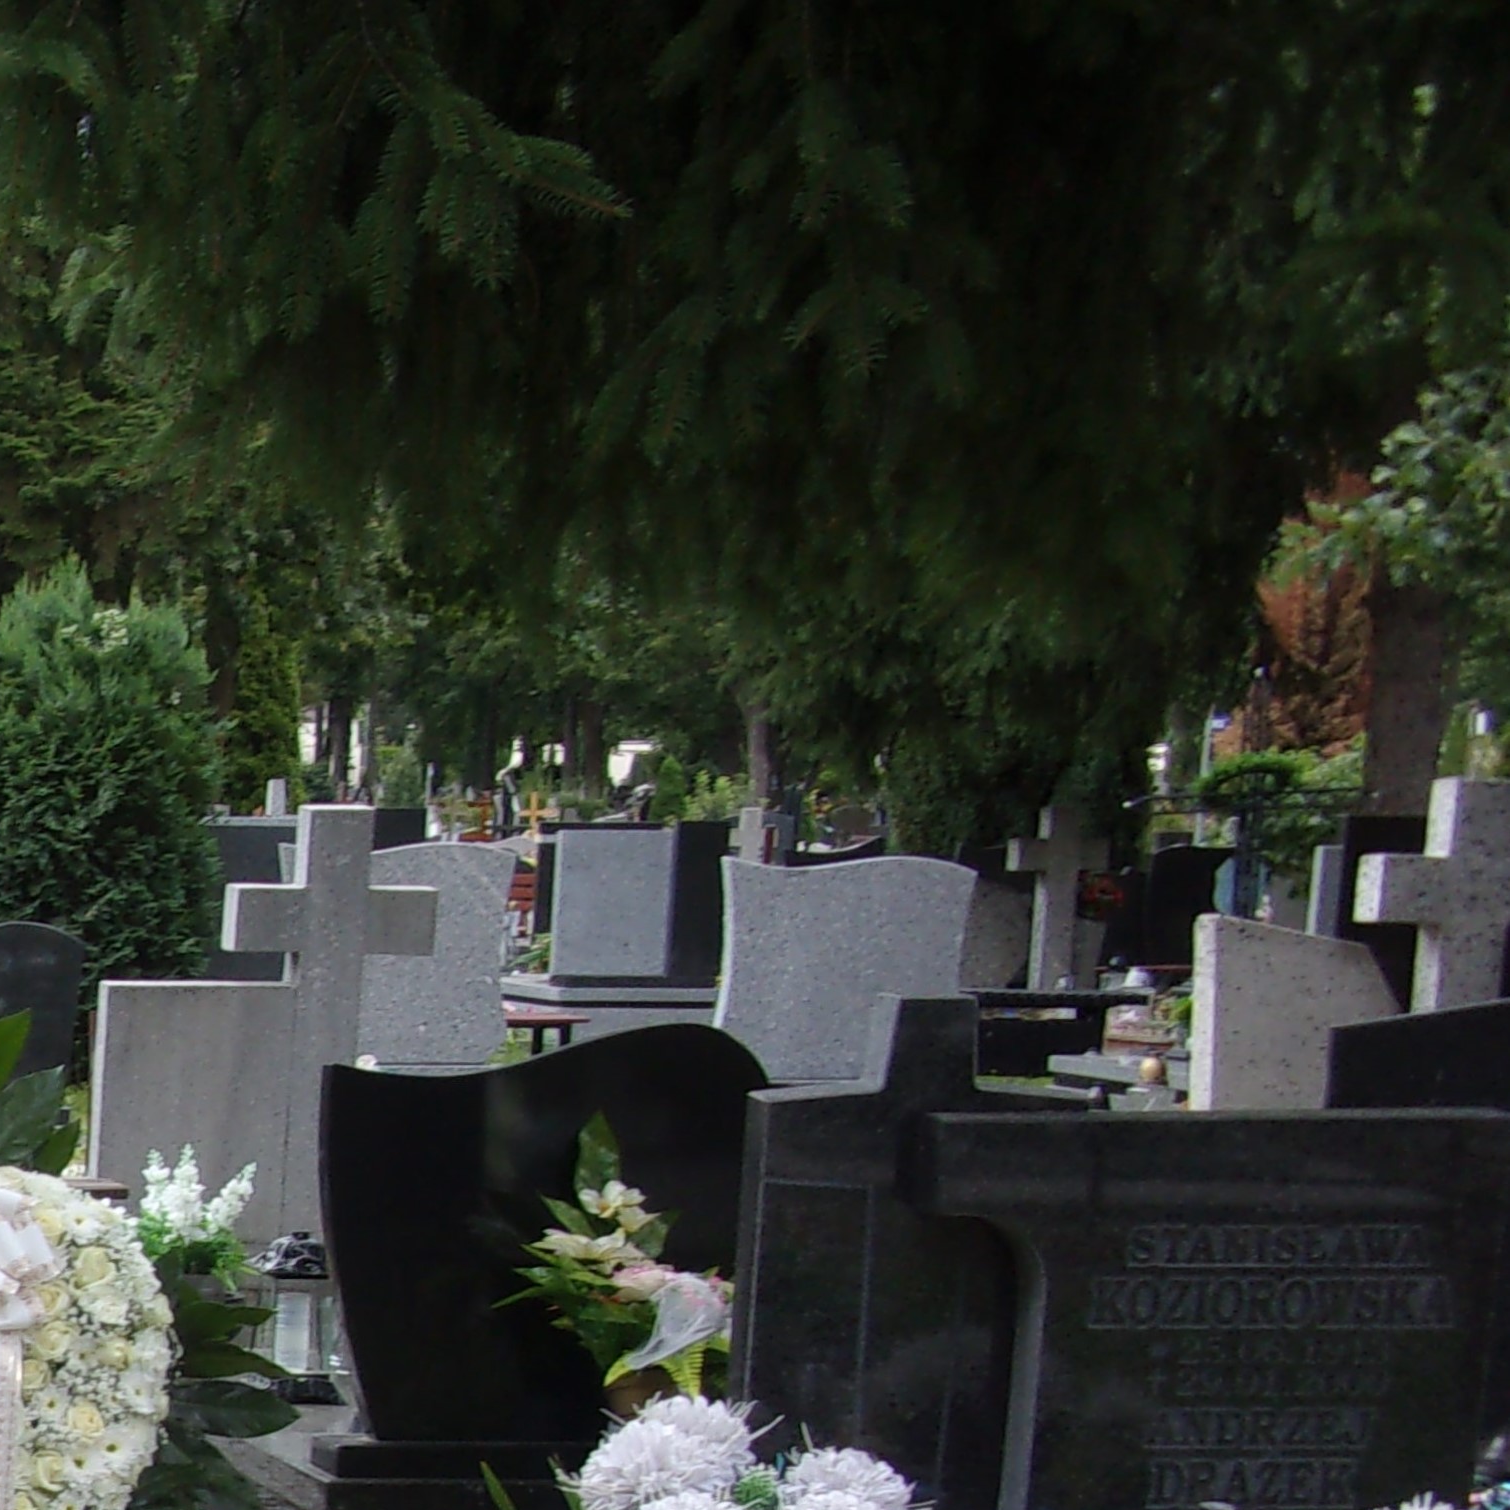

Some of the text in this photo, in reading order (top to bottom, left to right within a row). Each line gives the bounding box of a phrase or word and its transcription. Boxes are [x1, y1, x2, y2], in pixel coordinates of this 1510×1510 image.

[1128, 1224, 1428, 1266] STANISŁAWA
[1088, 1276, 1454, 1328] KOZIOROWSKA
[1143, 1407, 1375, 1448] ANDRZEJ
